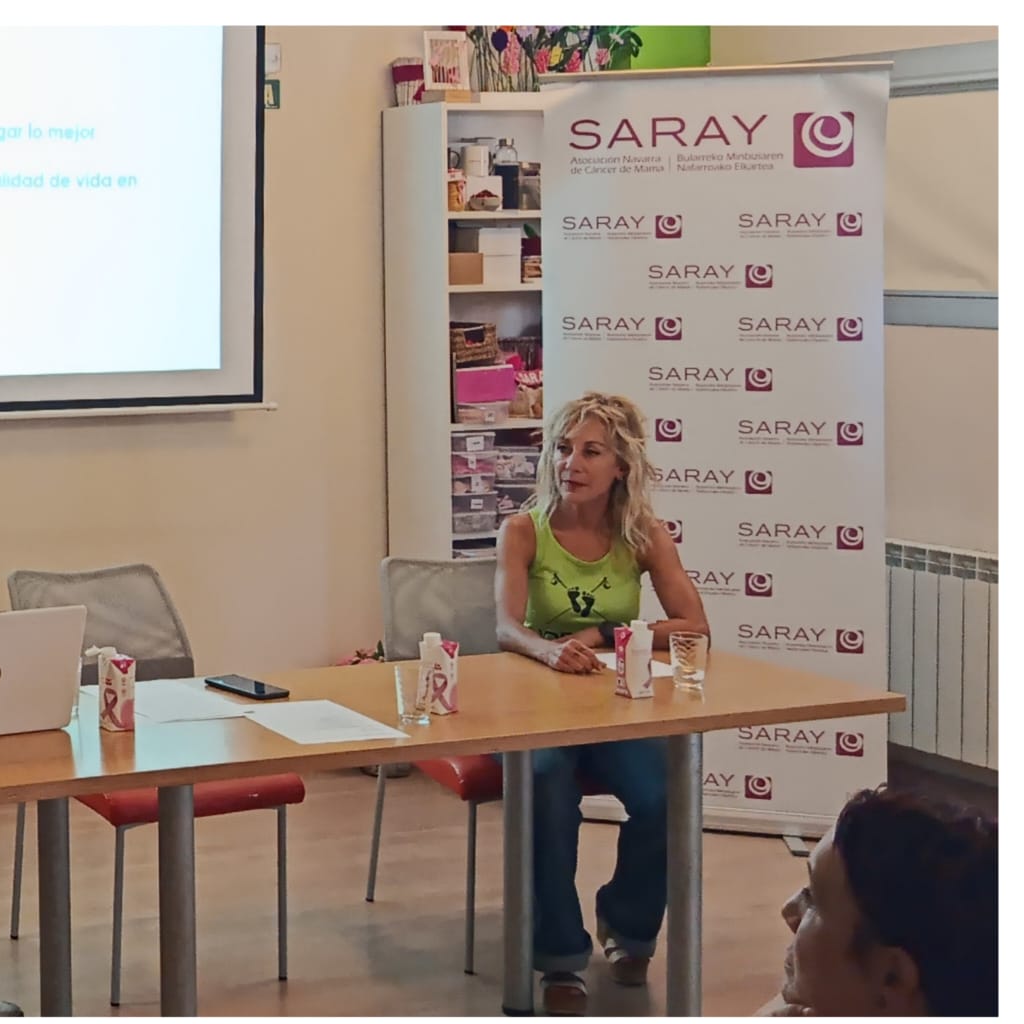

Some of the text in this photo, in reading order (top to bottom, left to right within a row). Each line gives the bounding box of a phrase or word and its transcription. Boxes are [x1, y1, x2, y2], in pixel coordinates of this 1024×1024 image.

[28, 123, 43, 139] lo
[48, 124, 95, 142] mejor
[569, 114, 767, 150] SARAY
[623, 154, 661, 164] Navarra
[571, 165, 582, 175] de
[621, 164, 632, 174] de
[634, 164, 664, 174] Mama
[49, 173, 70, 188] de
[76, 173, 112, 188] vida
[117, 175, 138, 188] en
[562, 215, 646, 230] SARAY
[738, 213, 826, 228] SARAY
[648, 264, 735, 280] SARAY
[562, 316, 646, 331] SARAY
[738, 317, 826, 332] SARAY
[648, 366, 735, 381] SARAY
[738, 420, 826, 435] SARAY
[650, 468, 735, 484] SARAY
[738, 522, 826, 539] SARAY
[685, 570, 735, 585] RAY
[738, 624, 826, 642] SARAY
[738, 726, 825, 744] SARAY
